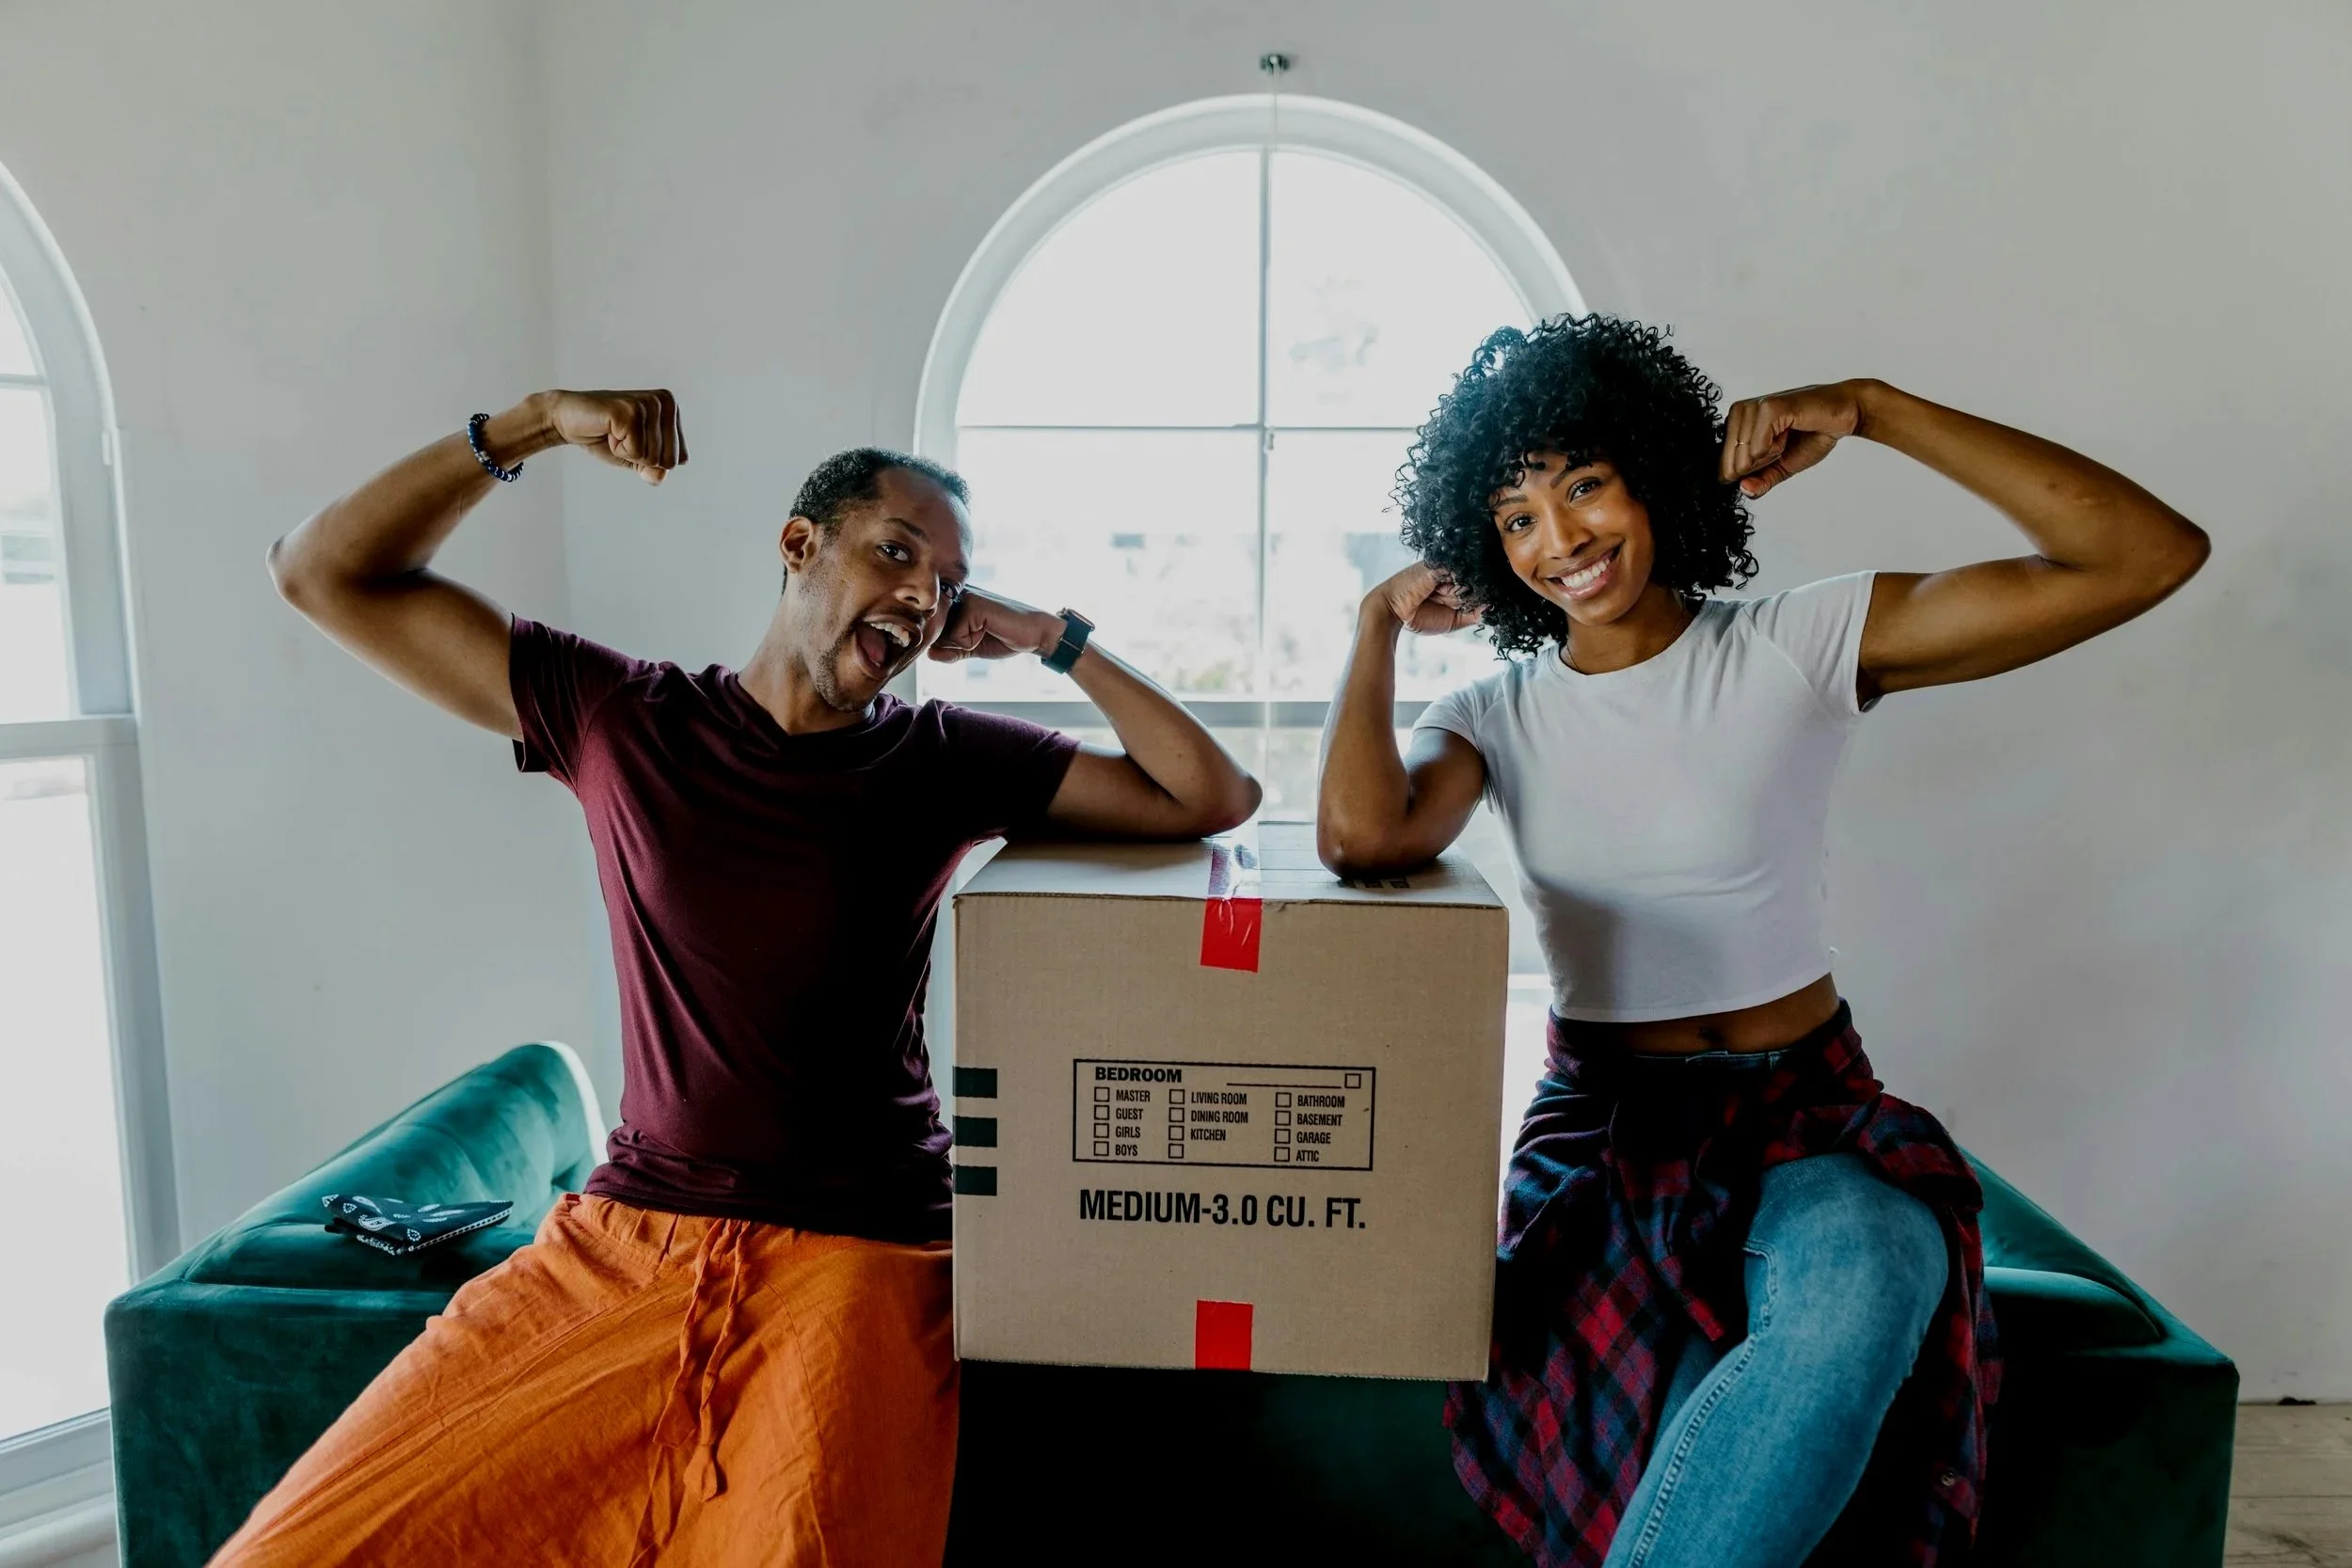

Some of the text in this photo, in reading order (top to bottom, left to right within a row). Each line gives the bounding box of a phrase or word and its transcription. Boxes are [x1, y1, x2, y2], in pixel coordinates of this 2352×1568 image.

[1095, 1067, 1182, 1083] BEDROOM
[1116, 1089, 1151, 1102] MASTER
[1191, 1092, 1248, 1105] LIVING ROOM
[1297, 1095, 1345, 1108] BATHROOM
[1116, 1108, 1144, 1120] GUEST
[1190, 1110, 1248, 1124] DINING ROOM
[1296, 1114, 1343, 1126] BASEMENT
[1116, 1126, 1141, 1138] GIRLS
[1190, 1129, 1226, 1141] KITCHEN
[1296, 1132, 1331, 1145] GARAGE
[1115, 1144, 1138, 1156] BOYS
[1295, 1149, 1320, 1163] ATTIC
[1080, 1189, 1366, 1228] MEDIUM-3.0 CU. FT.
